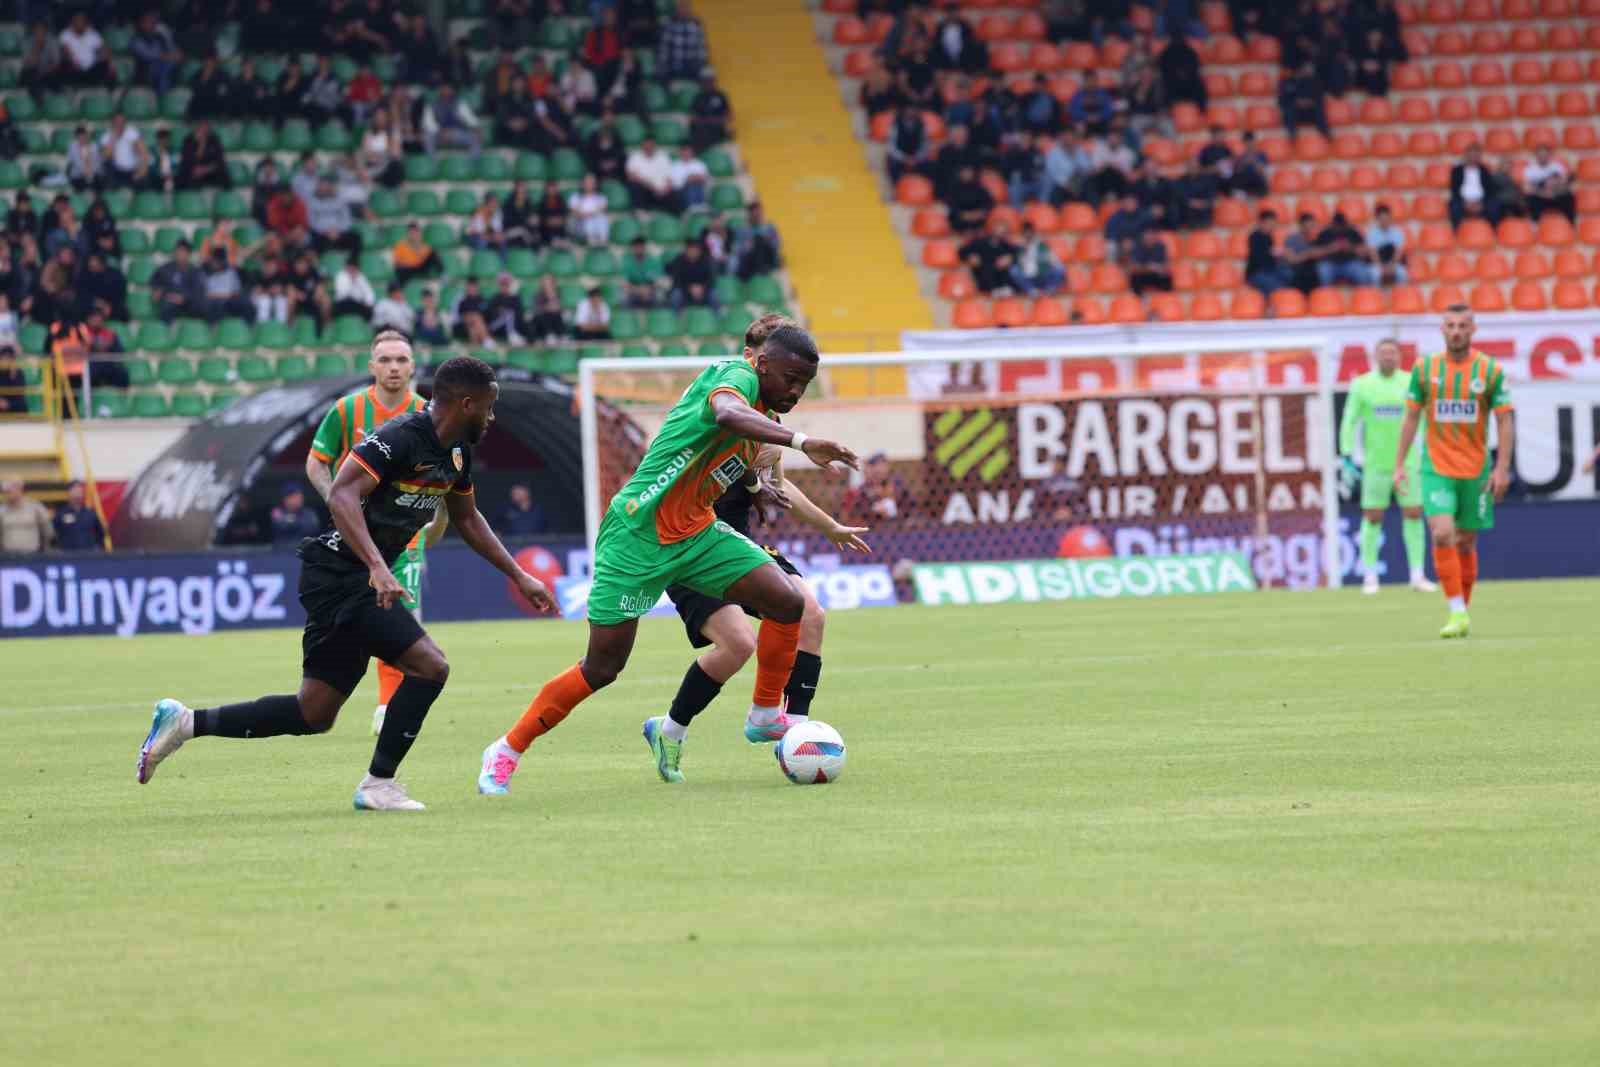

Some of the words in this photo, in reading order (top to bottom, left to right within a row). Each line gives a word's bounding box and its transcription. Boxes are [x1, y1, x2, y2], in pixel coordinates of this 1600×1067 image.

[640, 448, 694, 502] GROSUN
[0, 560, 286, 638] Dünyagöz
[914, 563, 1041, 605] HDI
